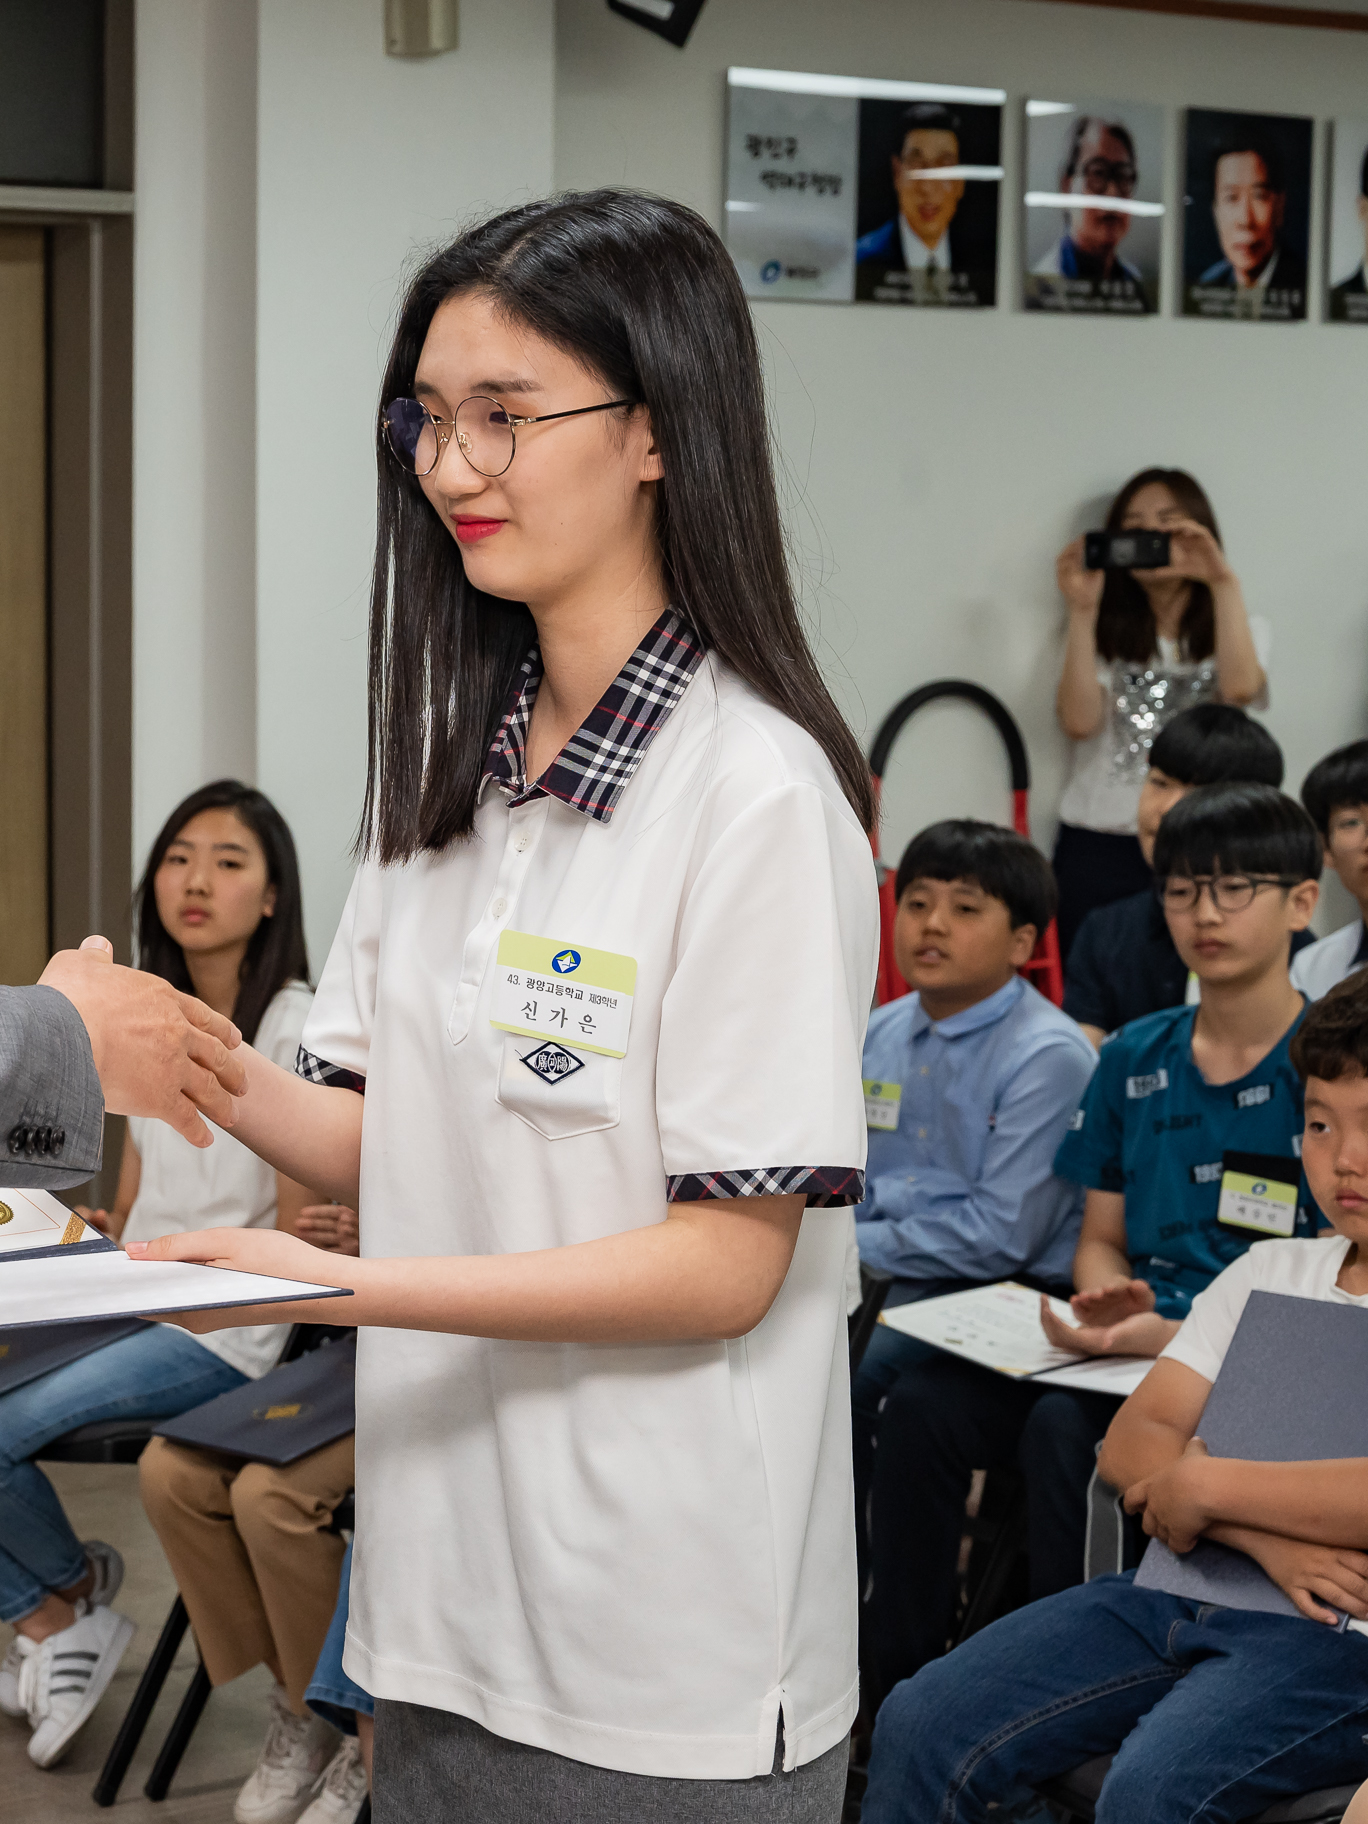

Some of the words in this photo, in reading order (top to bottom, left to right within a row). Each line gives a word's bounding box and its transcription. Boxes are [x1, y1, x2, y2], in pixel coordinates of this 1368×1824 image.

[507, 973, 521, 986] 43.
[526, 977, 584, 1001] 광양고등학교
[588, 992, 618, 1009] 제3학년
